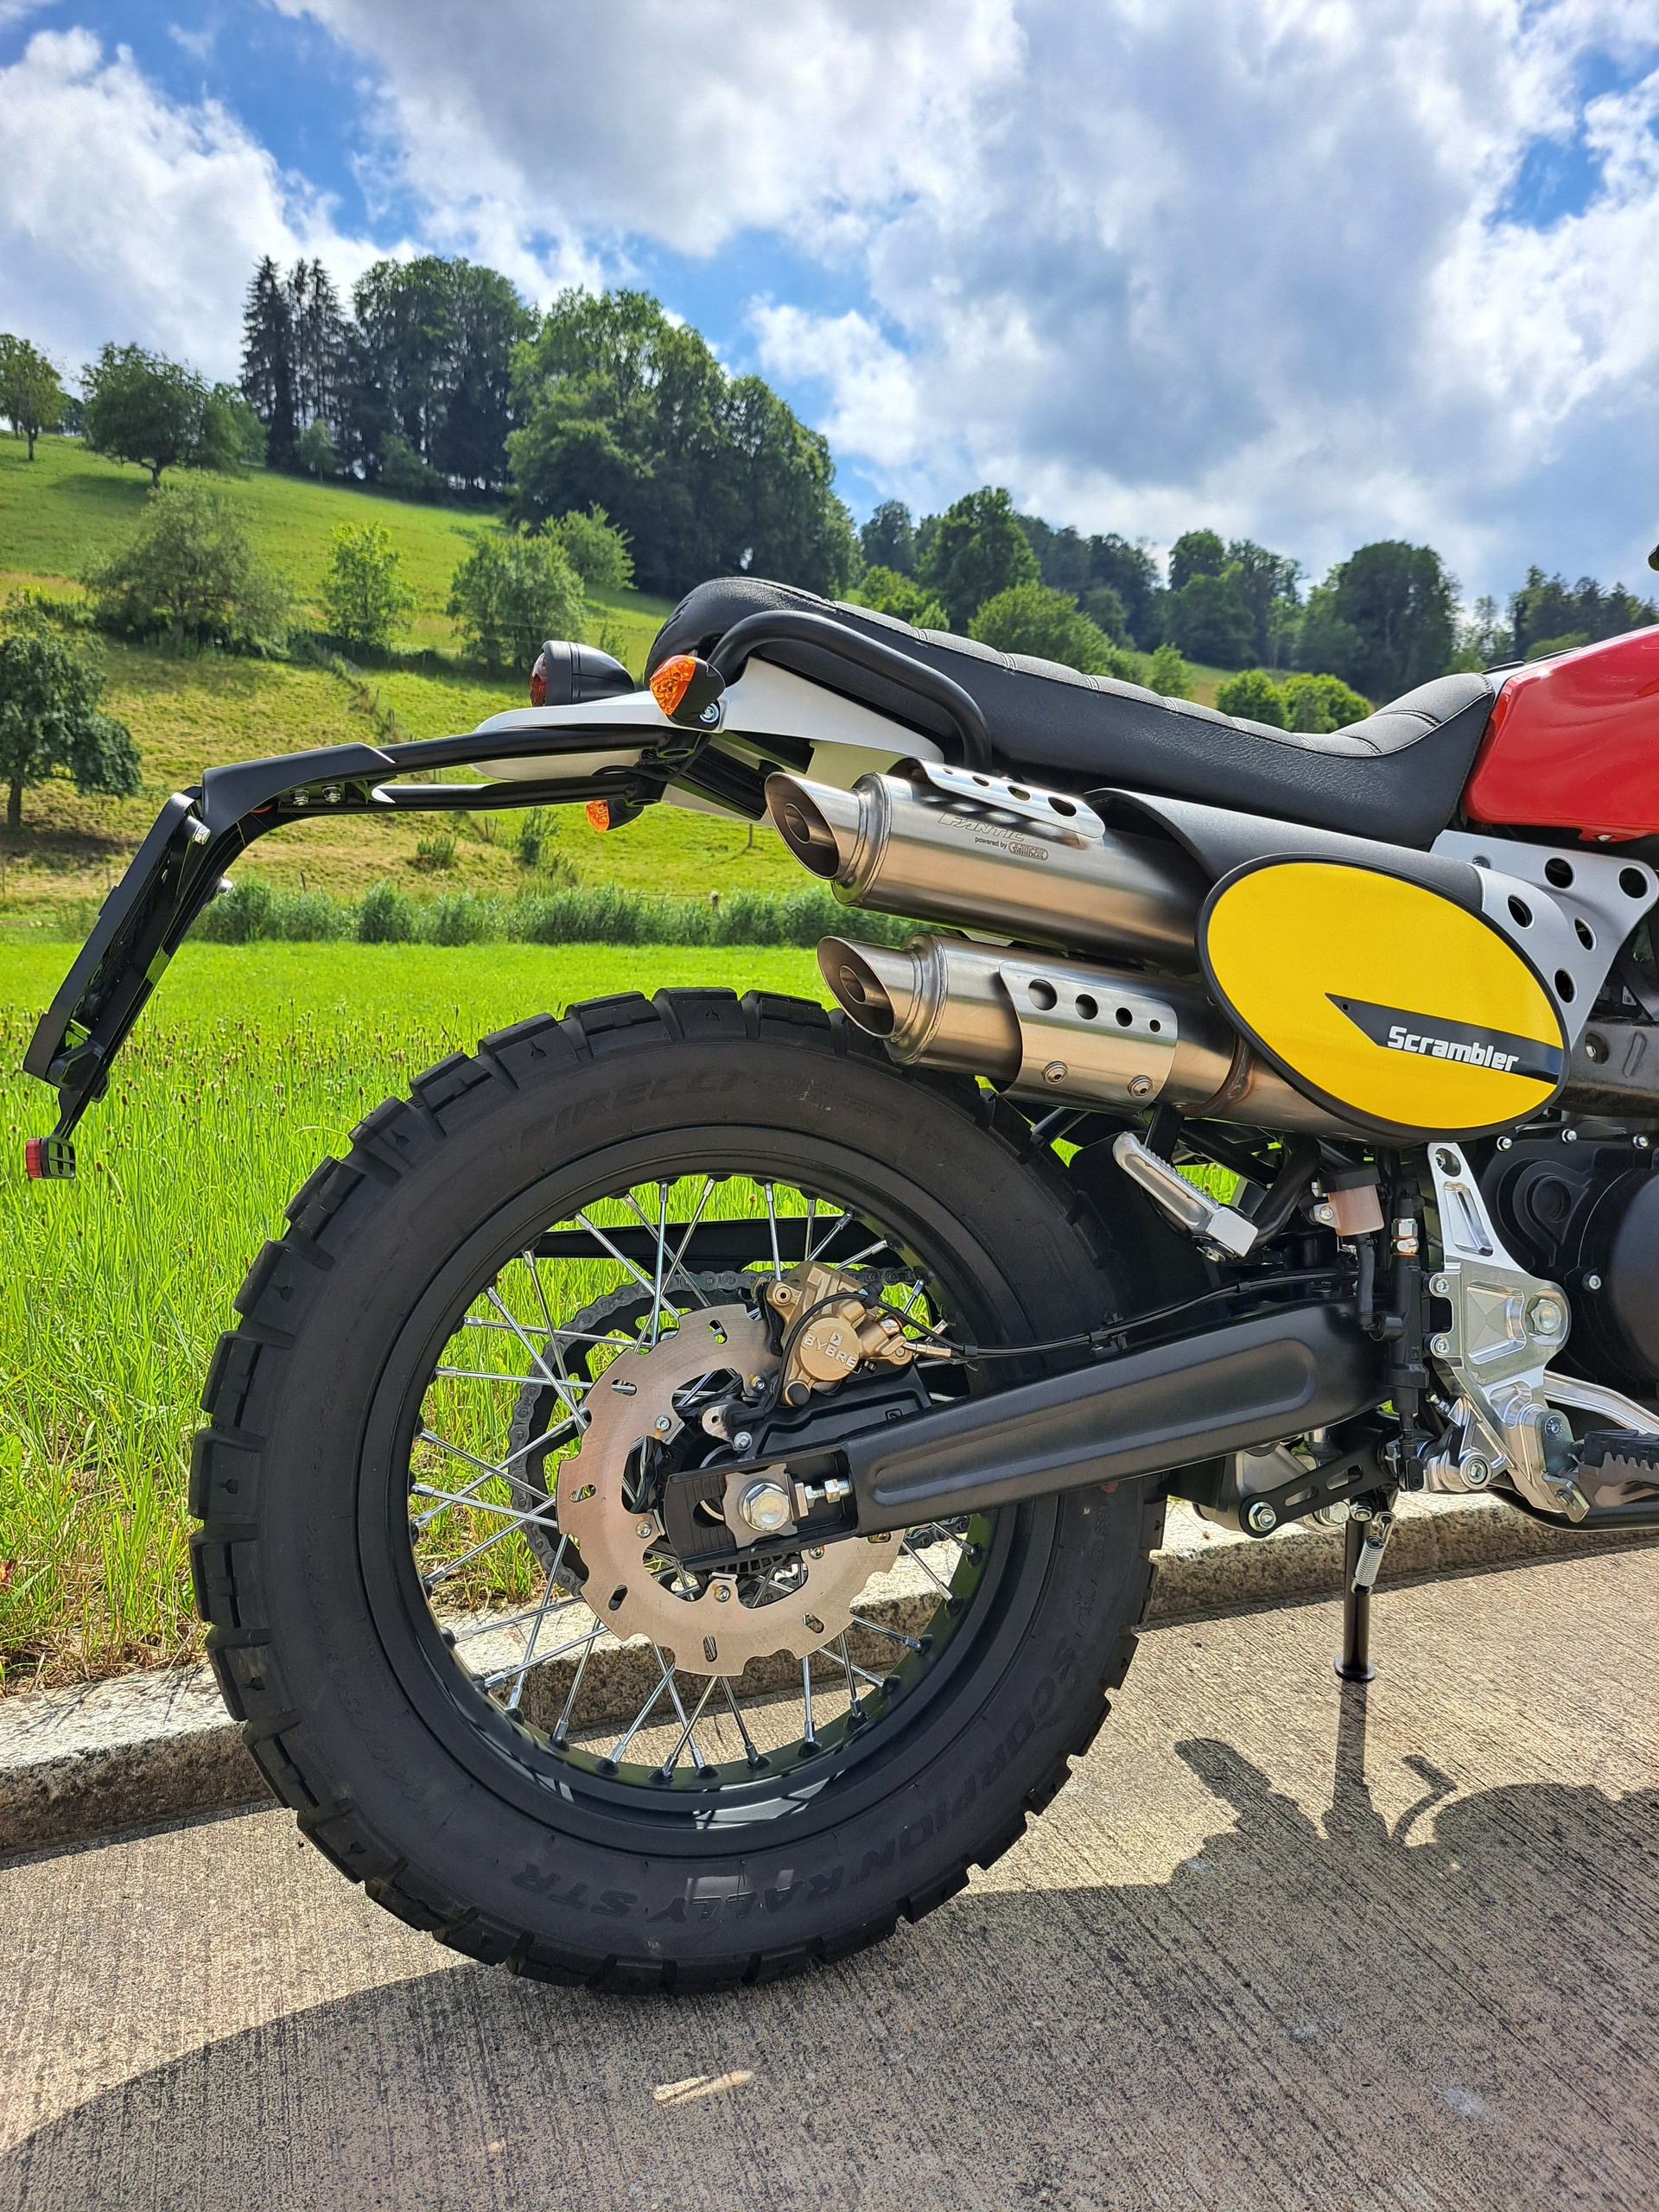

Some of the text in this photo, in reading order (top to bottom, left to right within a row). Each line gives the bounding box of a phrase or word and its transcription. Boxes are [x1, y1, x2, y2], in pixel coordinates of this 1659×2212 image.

[938, 811, 1025, 842] FANTIC
[975, 836, 1007, 849] powered by
[1387, 1026, 1519, 1071] Scrambler
[803, 1332, 859, 1368] BYBRE
[511, 1642, 1080, 1923] SCORPION RALLY STR
